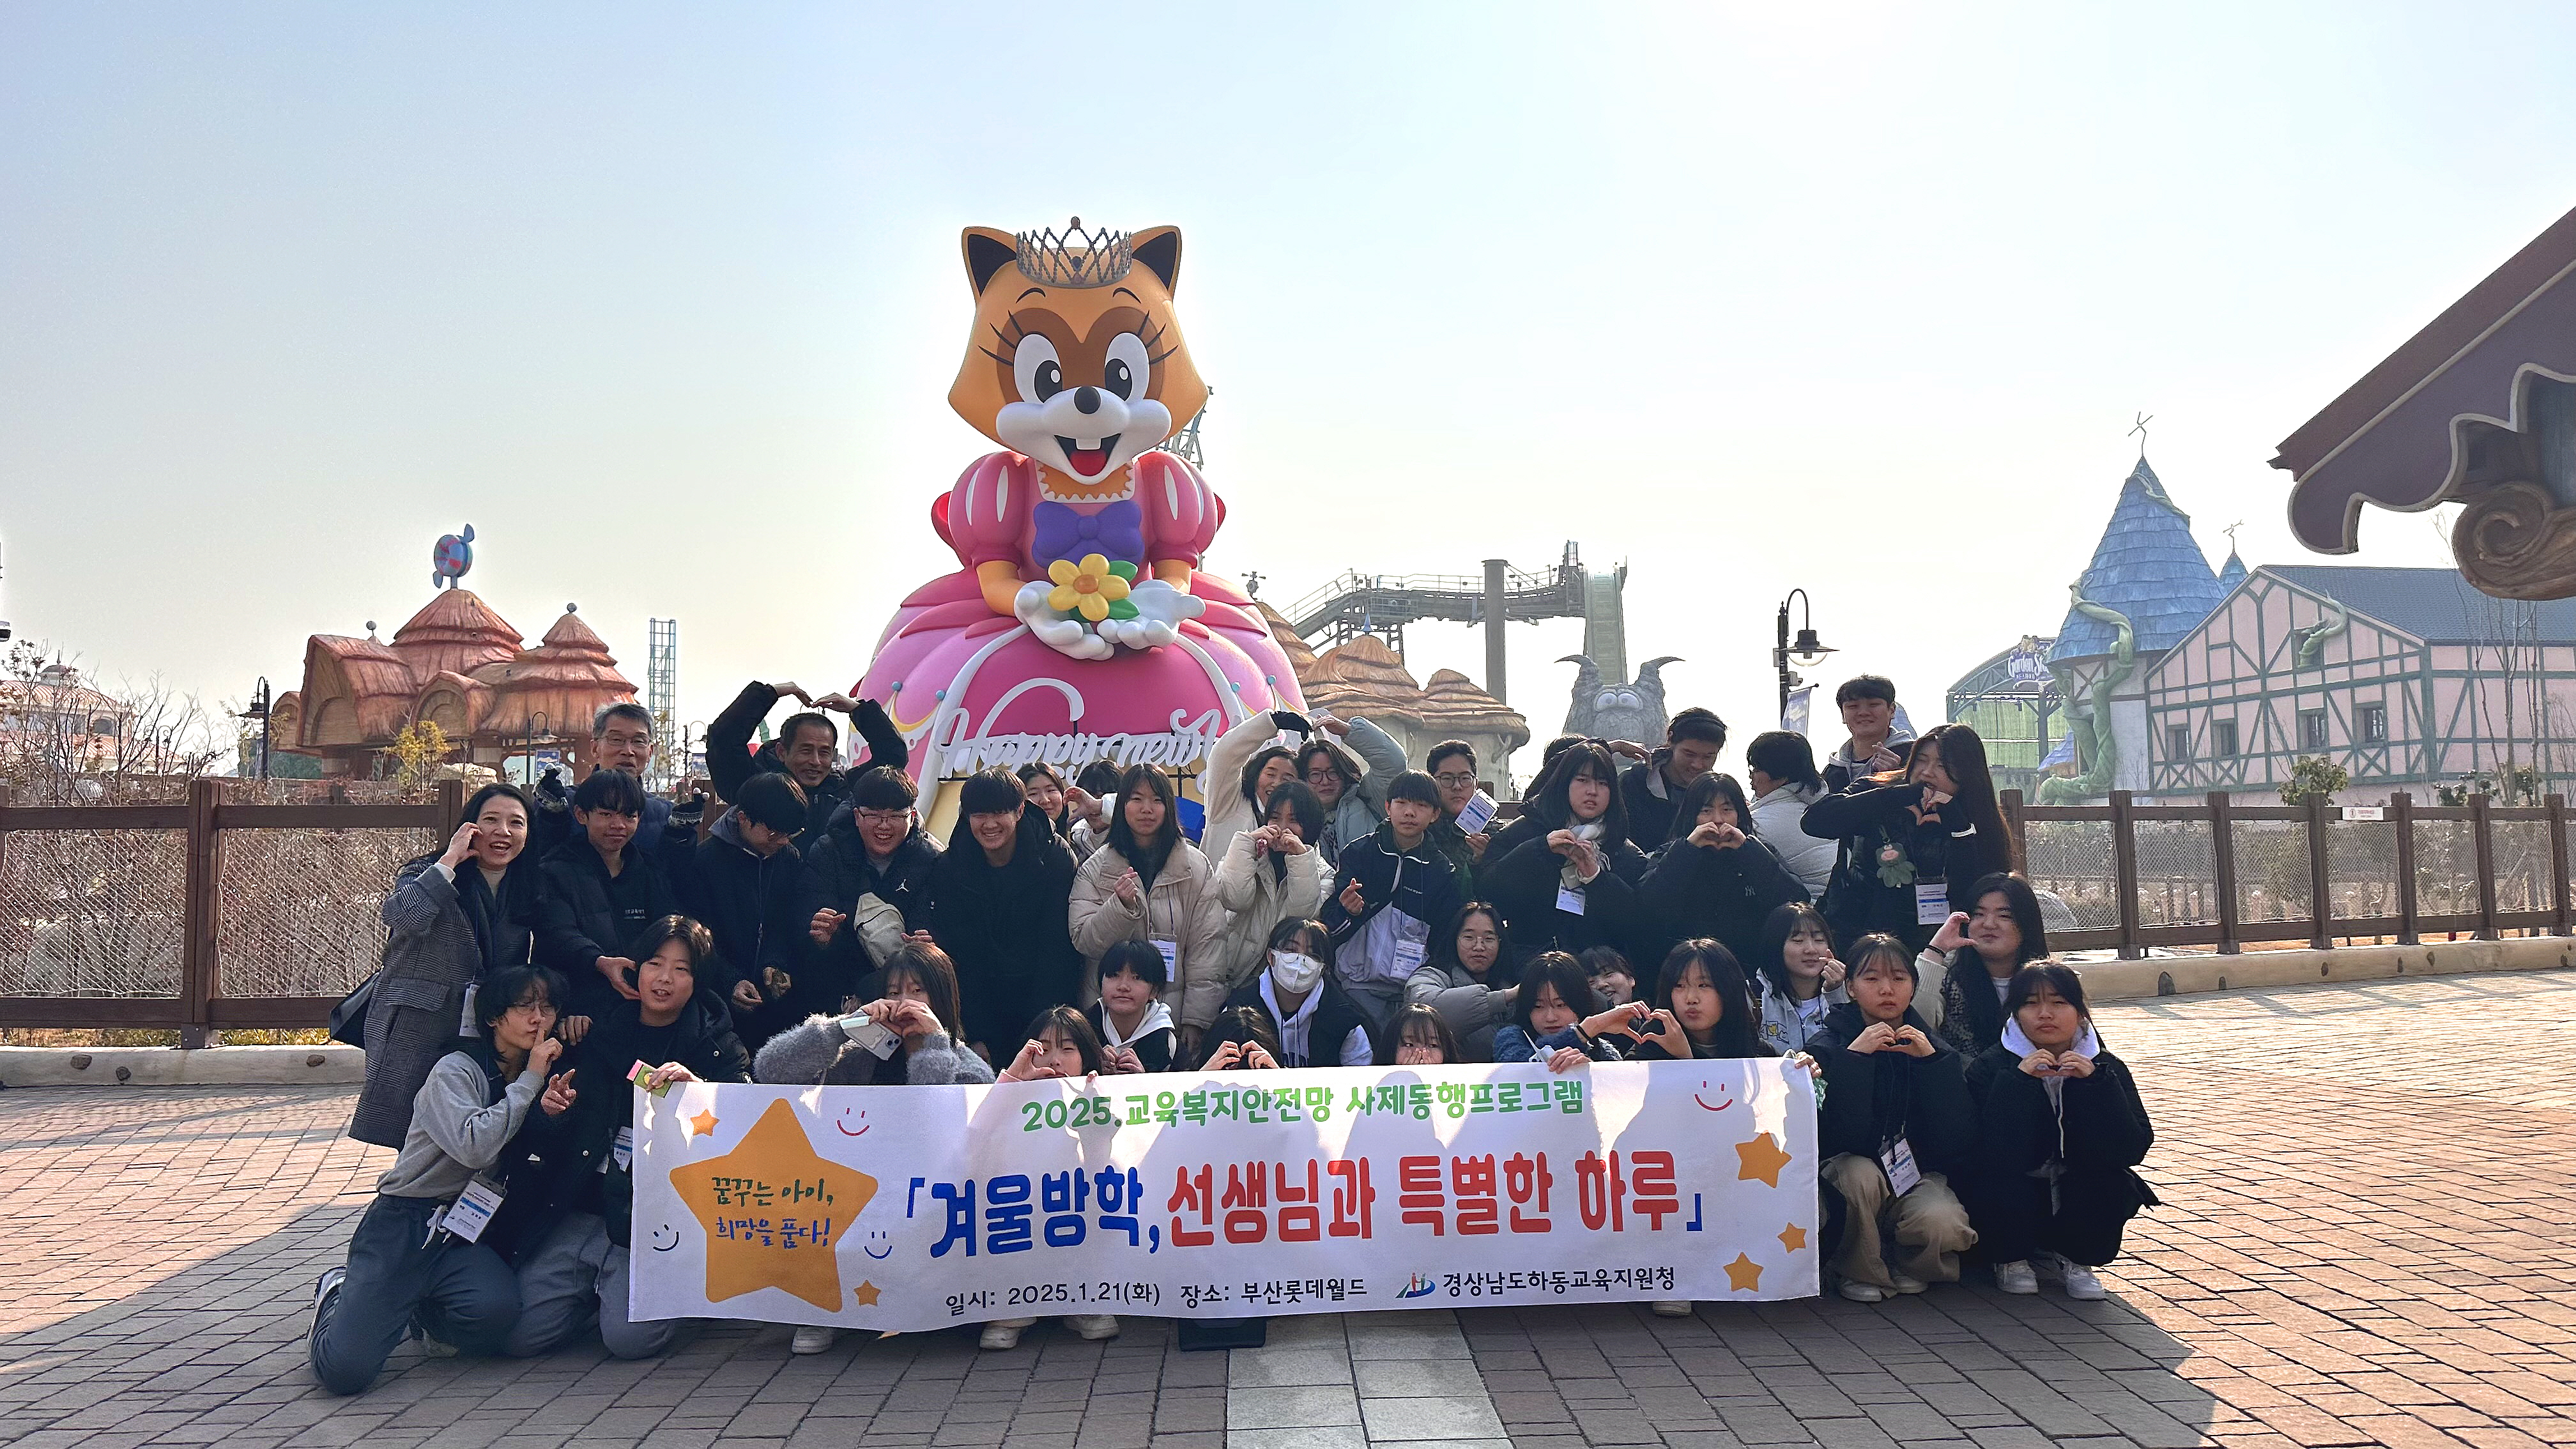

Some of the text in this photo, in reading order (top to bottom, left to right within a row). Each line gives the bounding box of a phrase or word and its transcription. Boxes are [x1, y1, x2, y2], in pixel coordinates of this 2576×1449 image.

[1346, 1080, 1583, 1121] 사제동행프로그램
[712, 1177, 834, 1207] 꿈꾸는 아이,
[1399, 1152, 1552, 1236] 특별한
[716, 1216, 831, 1248] 희망을 품다!
[946, 1278, 1367, 1316] 일시: 2025.1.21(화) 장소: 부산롯데월드
[1443, 1266, 1675, 1297] 경상남도하동교육지원청
